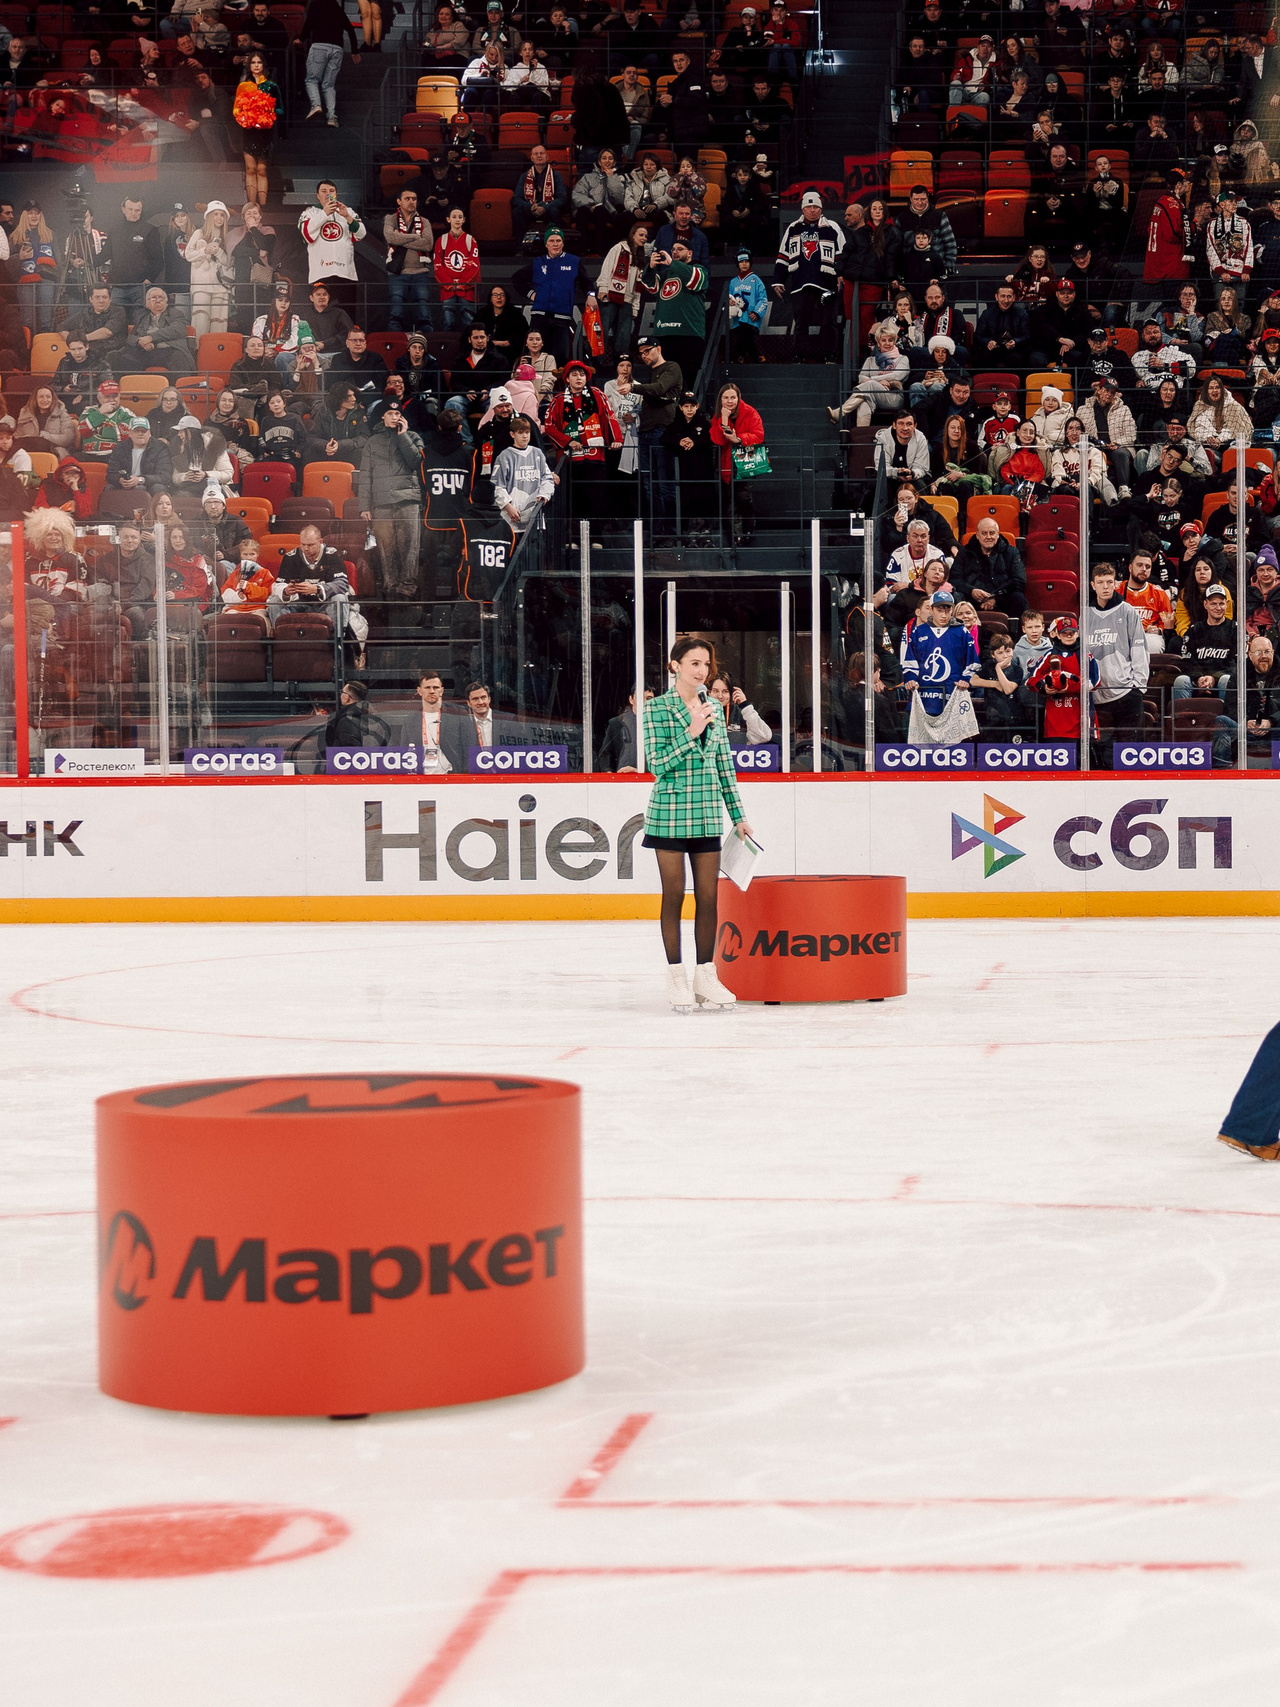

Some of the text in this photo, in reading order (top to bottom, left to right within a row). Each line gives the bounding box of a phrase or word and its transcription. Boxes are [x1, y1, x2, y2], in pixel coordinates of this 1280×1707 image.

[432, 474, 465, 494] 344
[478, 545, 505, 567] 182
[68, 762, 136, 773] Ростелеком
[365, 793, 646, 881] Haier
[1053, 799, 1232, 871] сбп
[748, 930, 902, 961] Маркет
[172, 1224, 565, 1314] Маркет
